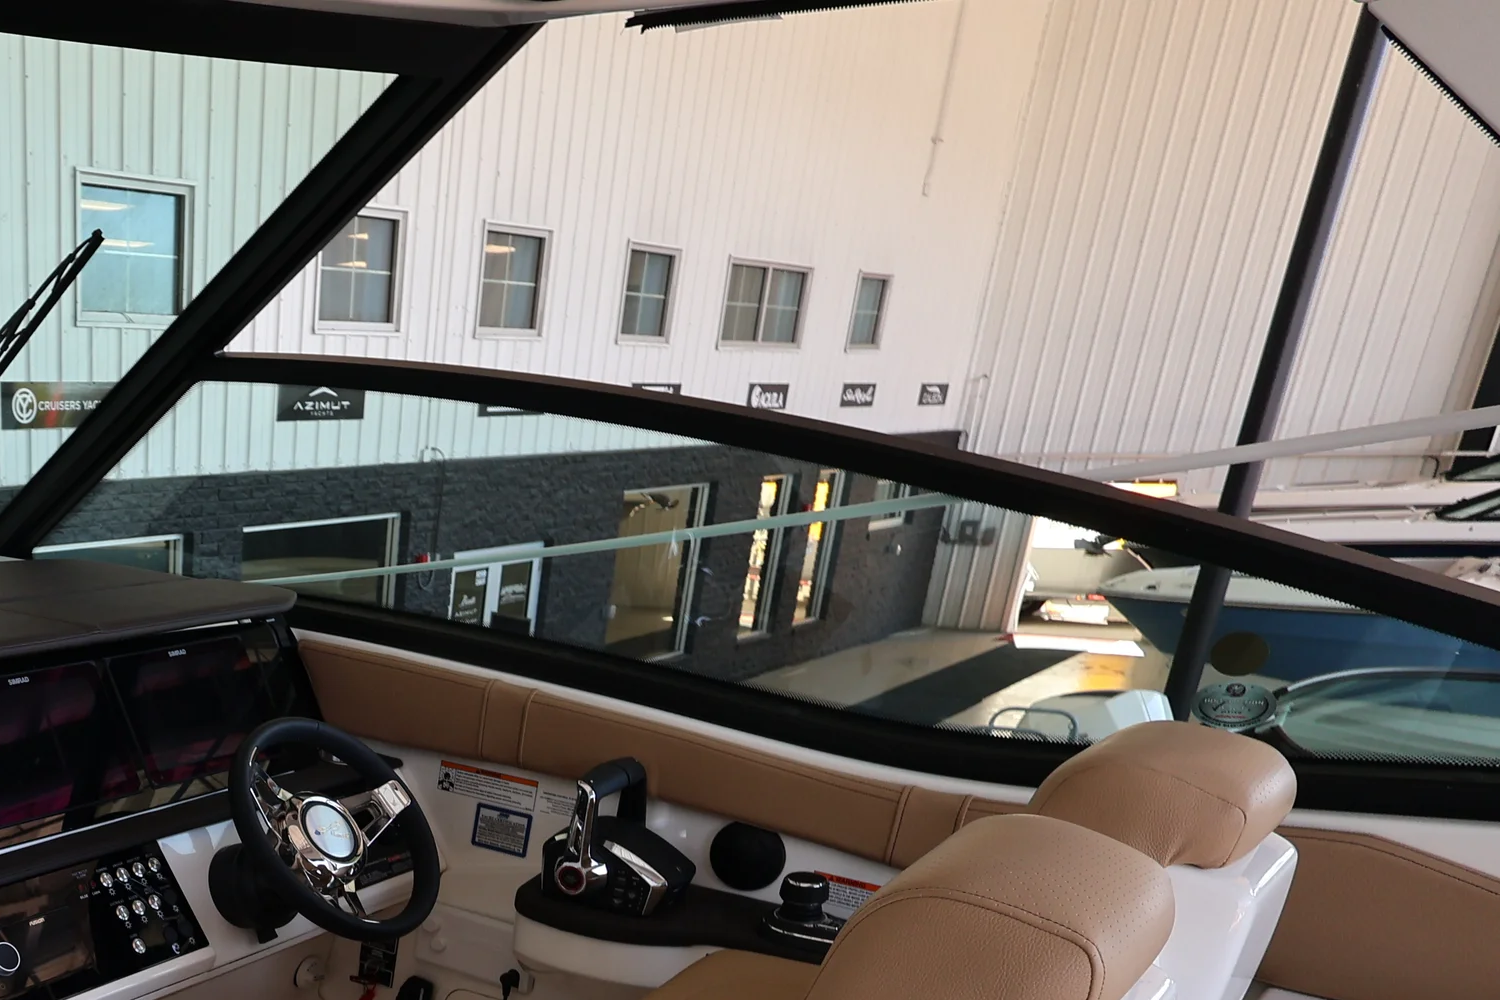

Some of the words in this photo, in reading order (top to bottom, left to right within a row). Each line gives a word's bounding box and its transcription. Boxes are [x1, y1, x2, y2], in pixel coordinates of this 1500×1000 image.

[38, 401, 81, 411] CRUISERS
[293, 400, 351, 411] AZIMUT
[168, 648, 187, 658] SIMRAD
[7, 676, 30, 686] SIMRAD
